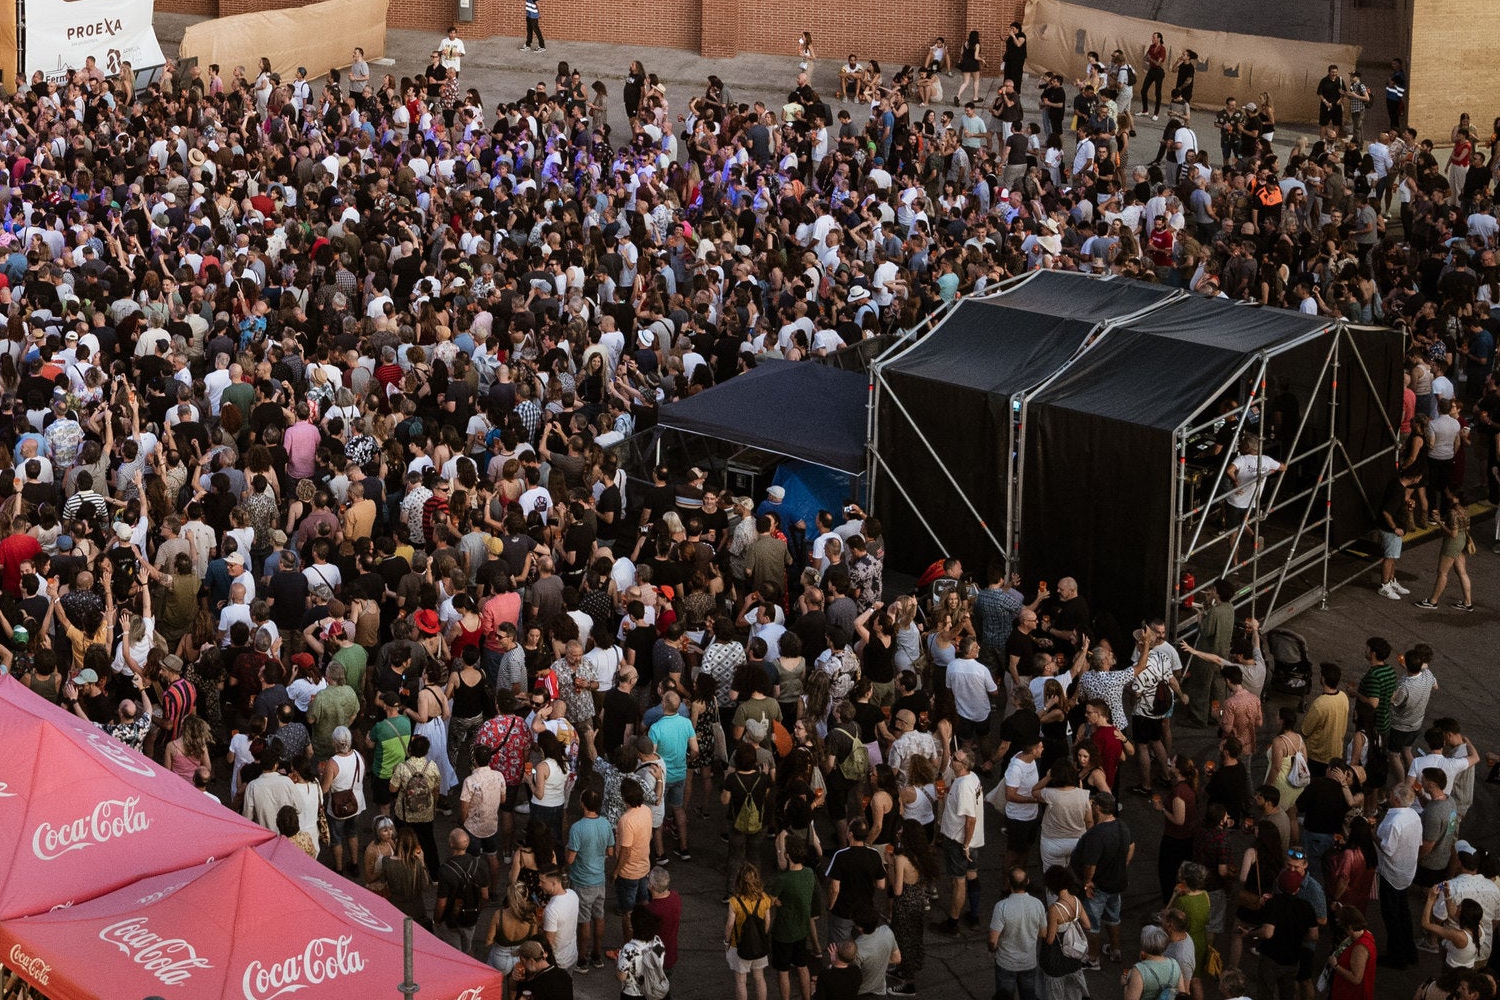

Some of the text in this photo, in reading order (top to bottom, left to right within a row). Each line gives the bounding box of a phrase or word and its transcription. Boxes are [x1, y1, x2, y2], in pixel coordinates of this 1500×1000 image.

[67, 18, 123, 40] PROEXA
[32, 794, 151, 861] Coca-Cola
[10, 943, 53, 986] Coca-Cola
[99, 917, 214, 987] Coca-Cola
[243, 933, 367, 1000] Coca-Cola
